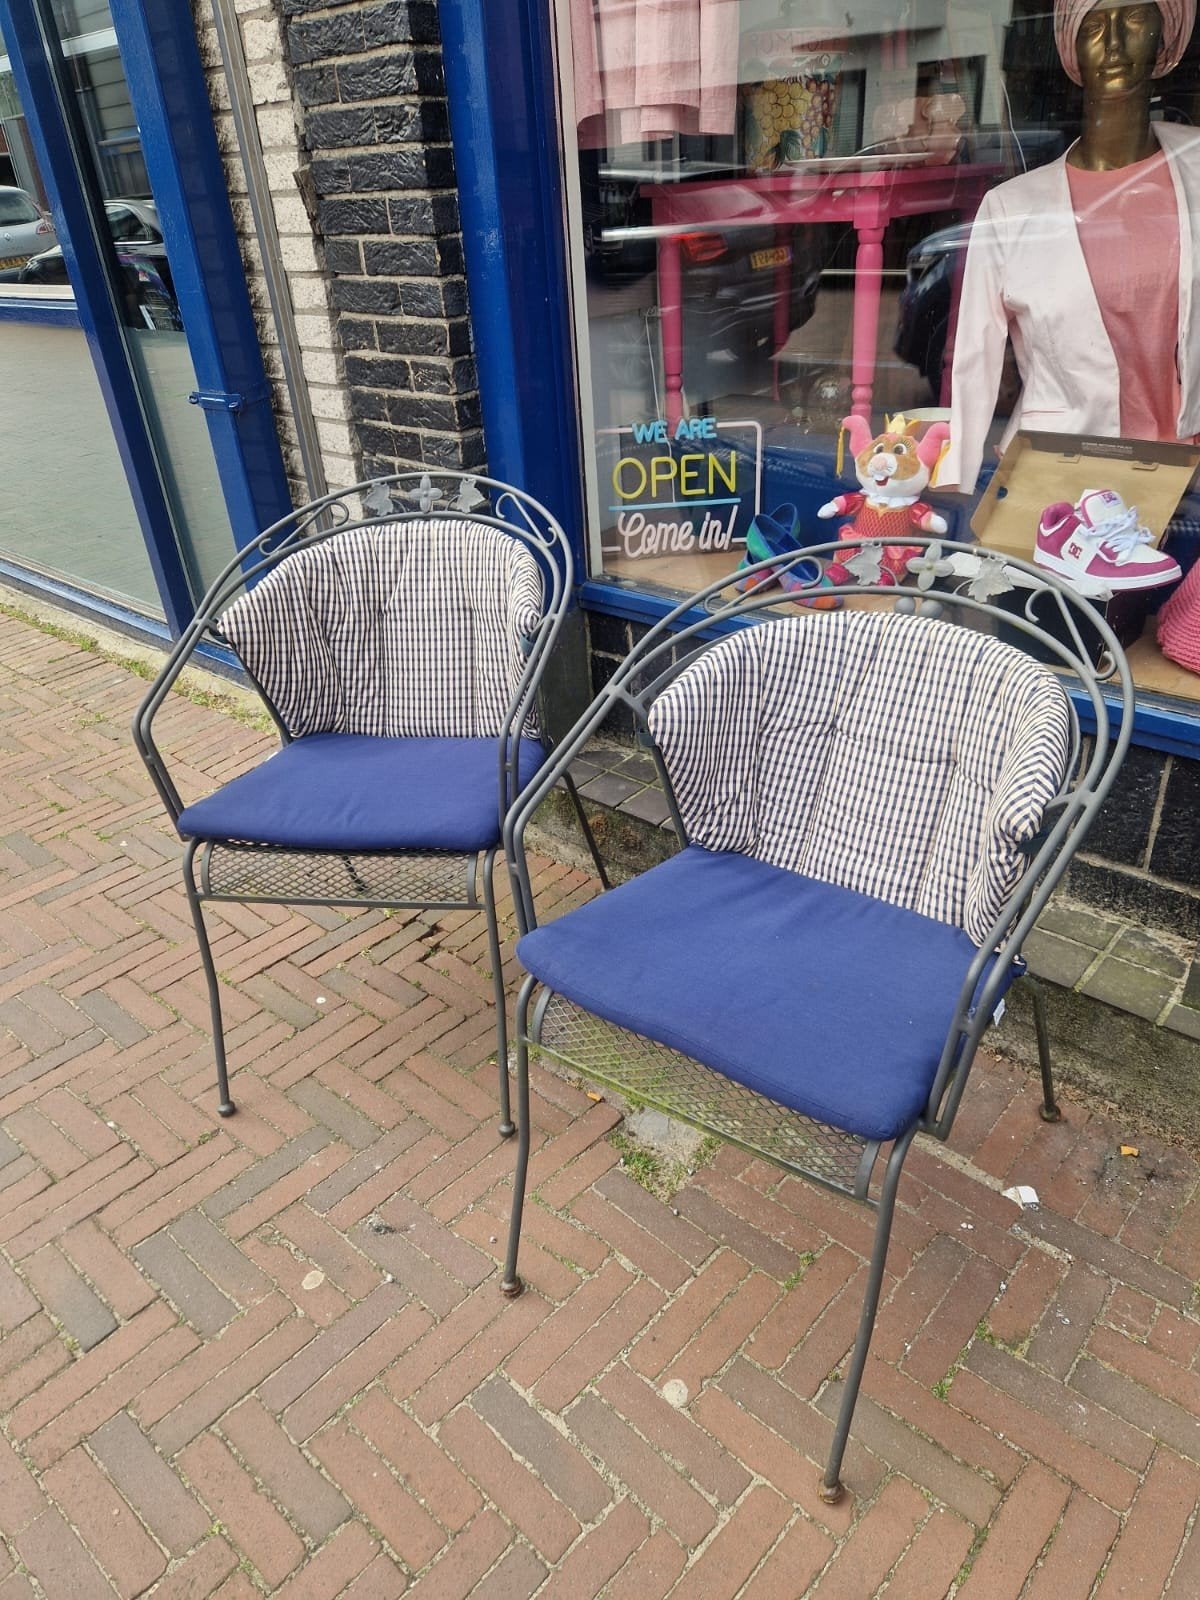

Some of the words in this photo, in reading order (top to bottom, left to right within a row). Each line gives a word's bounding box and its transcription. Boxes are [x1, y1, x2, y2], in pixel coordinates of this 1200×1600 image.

[631, 419, 668, 444] WE
[675, 417, 717, 440] ARE
[612, 450, 736, 499] OPEN
[617, 512, 695, 558] Come
[698, 504, 739, 551] in!
